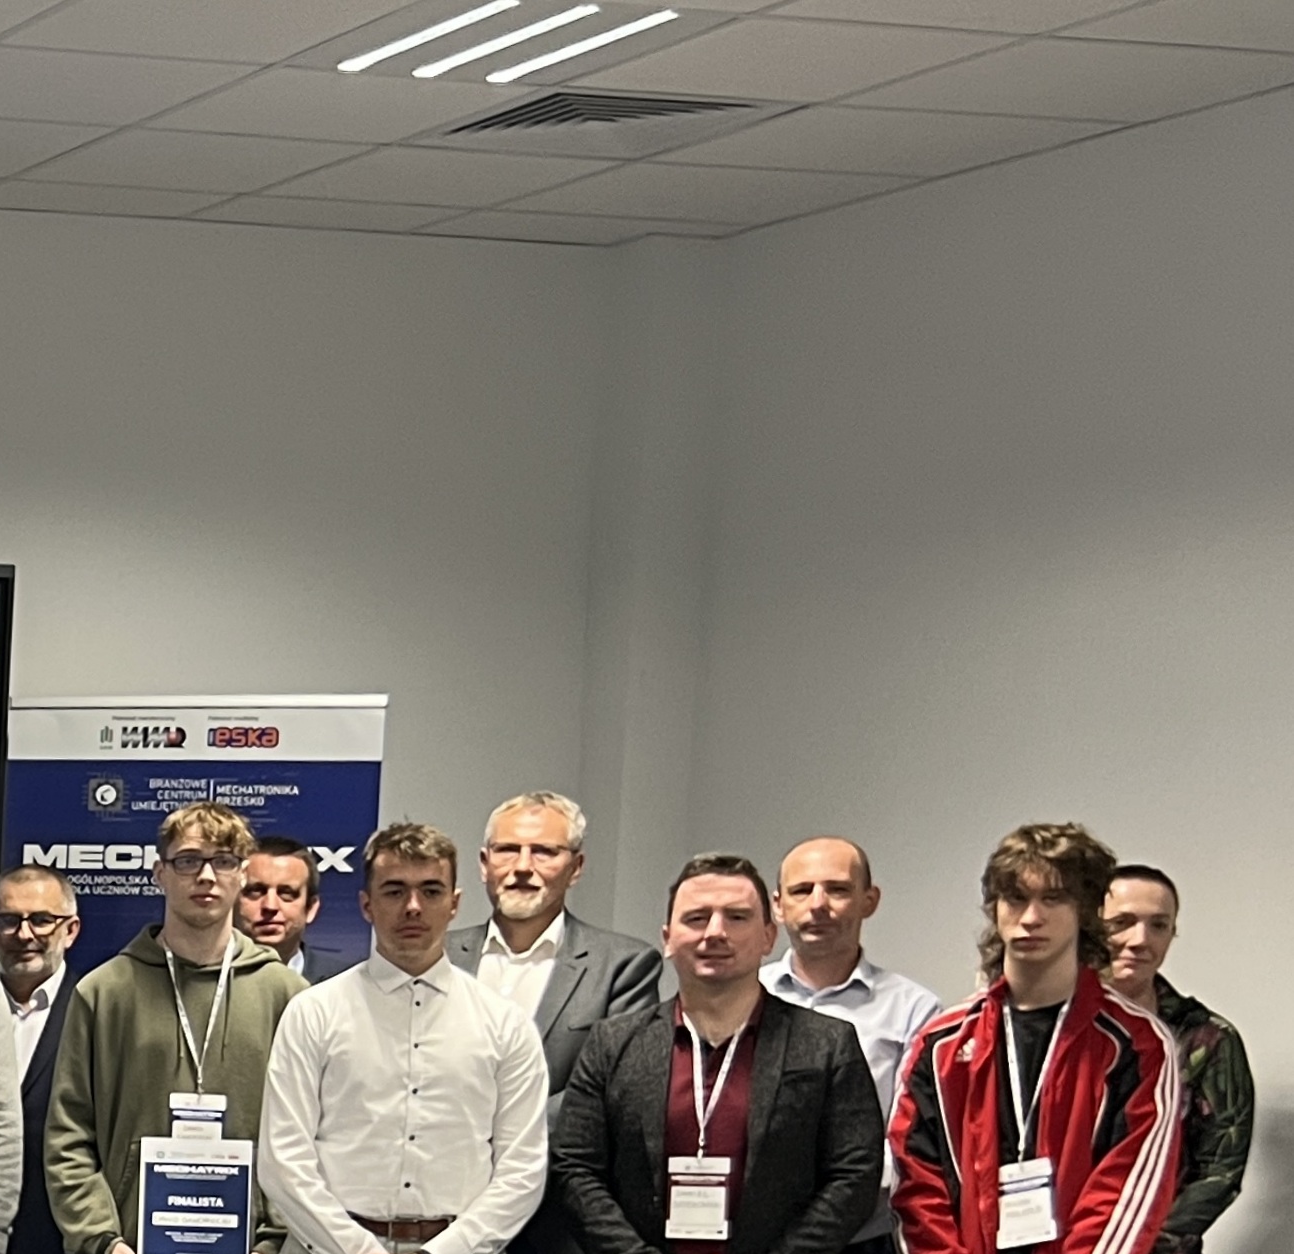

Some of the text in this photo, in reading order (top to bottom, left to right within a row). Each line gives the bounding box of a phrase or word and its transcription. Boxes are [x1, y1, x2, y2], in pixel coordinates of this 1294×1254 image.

[148, 778, 208, 789] BRANŻOWE
[156, 790, 208, 800] CENTRUM
[216, 785, 299, 796] MECHATRONIKA
[216, 796, 265, 807] BRZESKO
[67, 874, 149, 885] OGÓLNOPOLSKA
[92, 884, 140, 896] UCZNIÓW
[167, 1195, 224, 1208] FINALISTA
